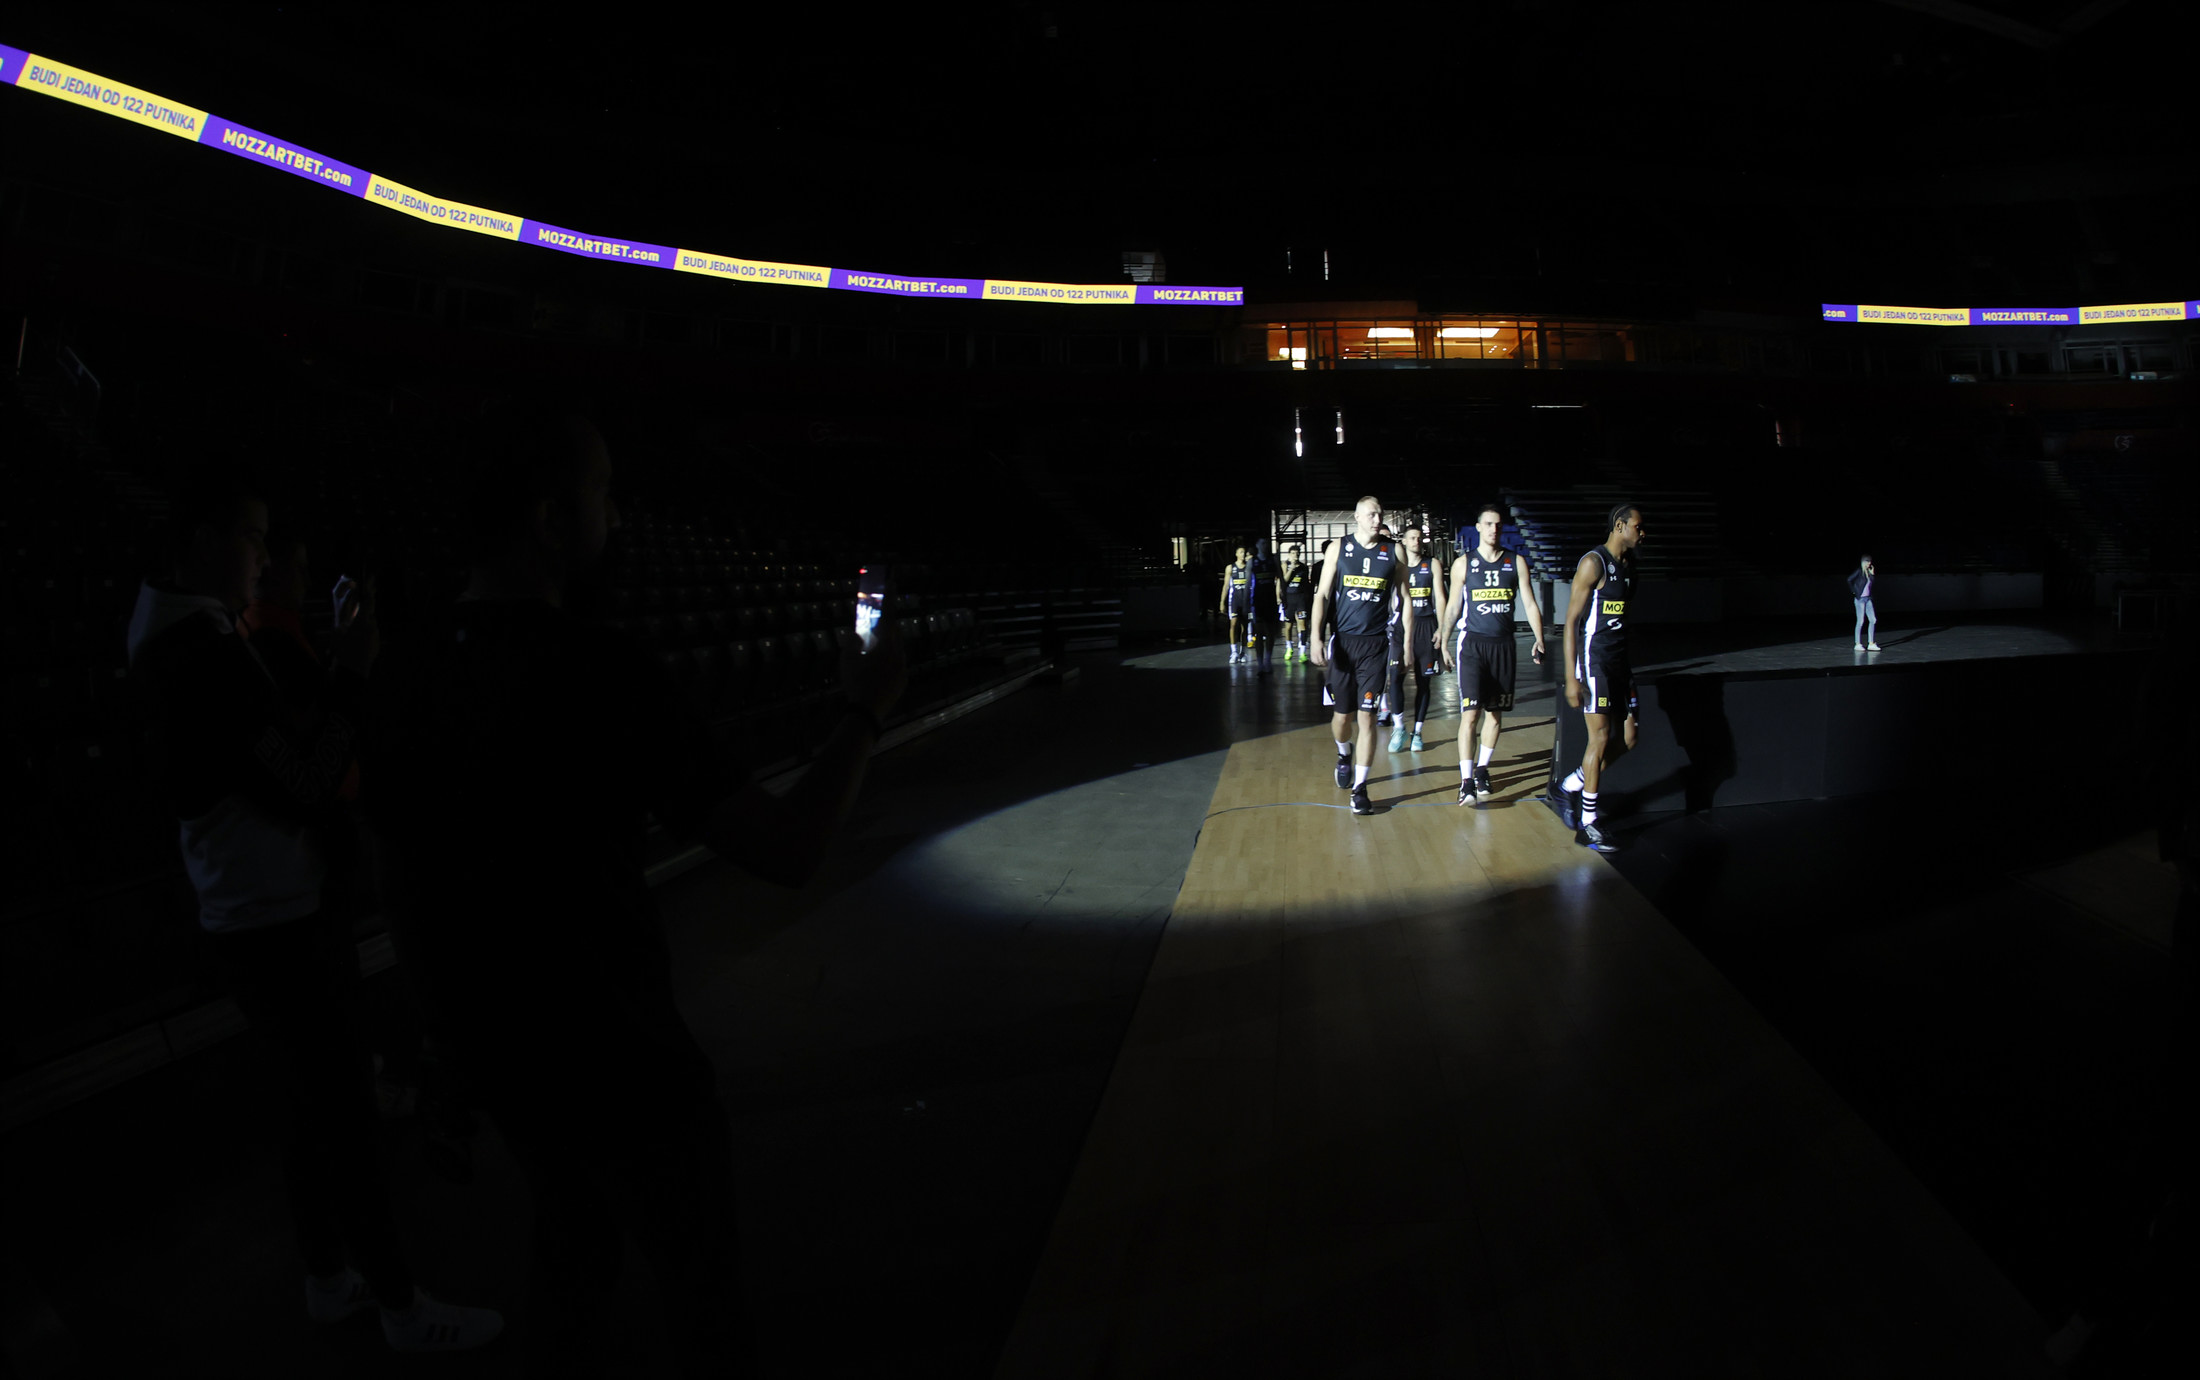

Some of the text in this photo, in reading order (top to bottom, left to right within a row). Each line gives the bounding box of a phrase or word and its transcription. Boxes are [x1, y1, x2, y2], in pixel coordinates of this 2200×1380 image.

[29, 65, 196, 132] BUDI JEDAN OD 122 PUTNIKA
[222, 127, 353, 187] MOZZARTBET.com
[374, 183, 514, 234] BUDI JEDAN OD 122 PUTNIKA
[538, 228, 660, 263] MOZZARTBET.com
[682, 255, 823, 283] BUDI JEDAN OD 122 PUTNIKA
[847, 274, 967, 295] MOZZARTBET.com
[990, 285, 1129, 300] BUDI JEDAN OD 122 PUTNIKA
[1154, 289, 1243, 302] MOZZARTBET
[1863, 310, 1965, 322] BUDI JEDAN OD 122 PUTNIKA
[1982, 312, 2069, 322] MOZZARTBET.com
[2084, 307, 2181, 320] BUDI JEDAN OD 122 PUTNIKA
[1362, 557, 1371, 574] 9
[1484, 570, 1500, 587] 33
[1492, 603, 1511, 613] NIS
